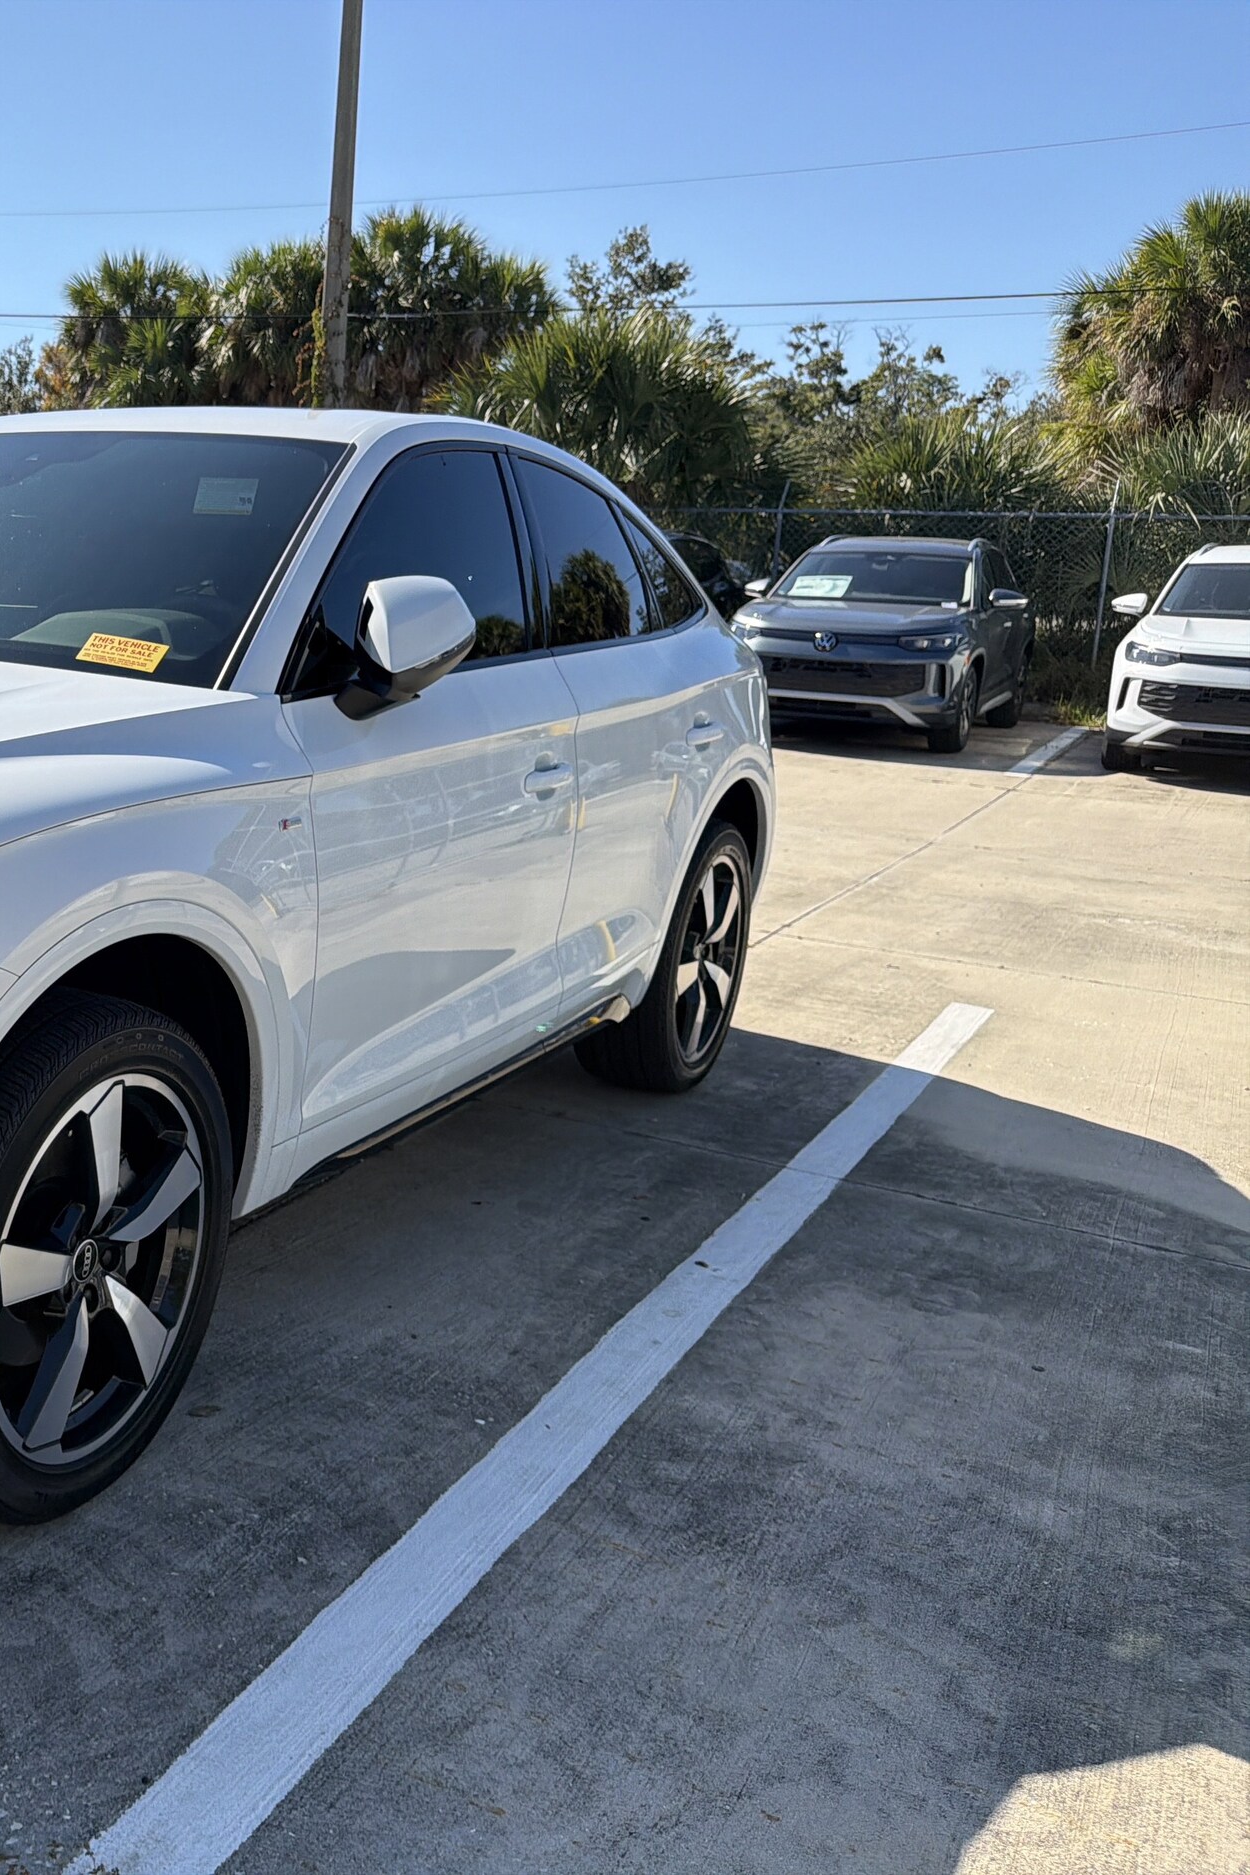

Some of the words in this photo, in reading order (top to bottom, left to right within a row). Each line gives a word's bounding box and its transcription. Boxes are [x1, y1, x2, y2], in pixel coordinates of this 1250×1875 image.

[90, 642, 109, 650] NOT
[130, 649, 153, 657] SALE
[92, 635, 115, 645] THIS
[118, 639, 161, 653] VEHICLE
